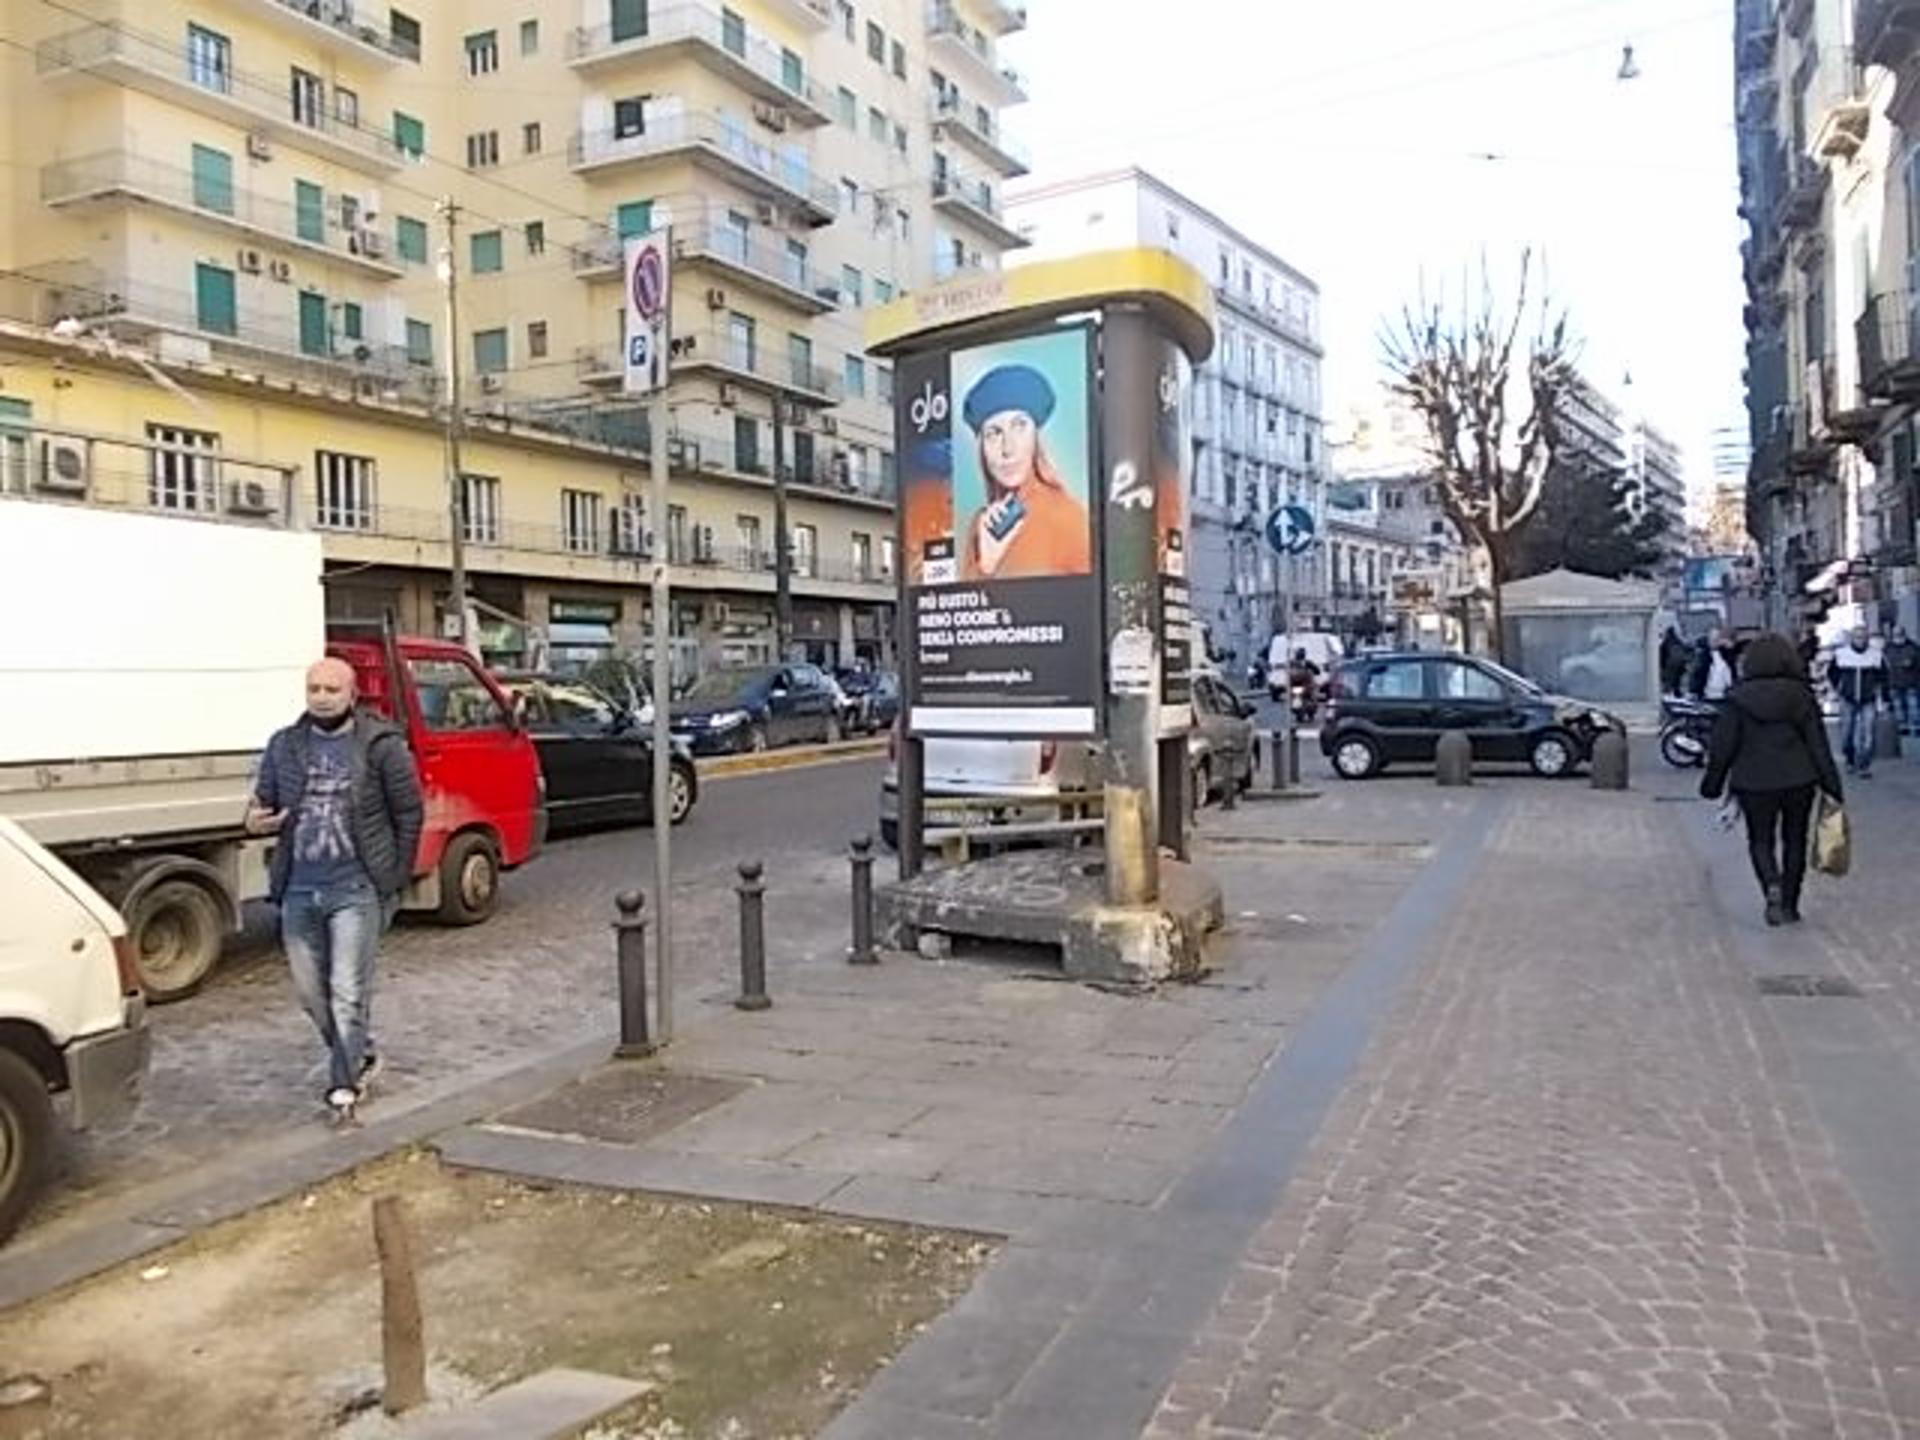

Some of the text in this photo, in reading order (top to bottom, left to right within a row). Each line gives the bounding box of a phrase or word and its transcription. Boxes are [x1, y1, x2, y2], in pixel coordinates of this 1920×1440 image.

[911, 382, 948, 432] glo
[938, 592, 979, 609] GUSTO
[918, 612, 951, 628] MENO
[919, 625, 1063, 646] SENZA COMPROMESSI
